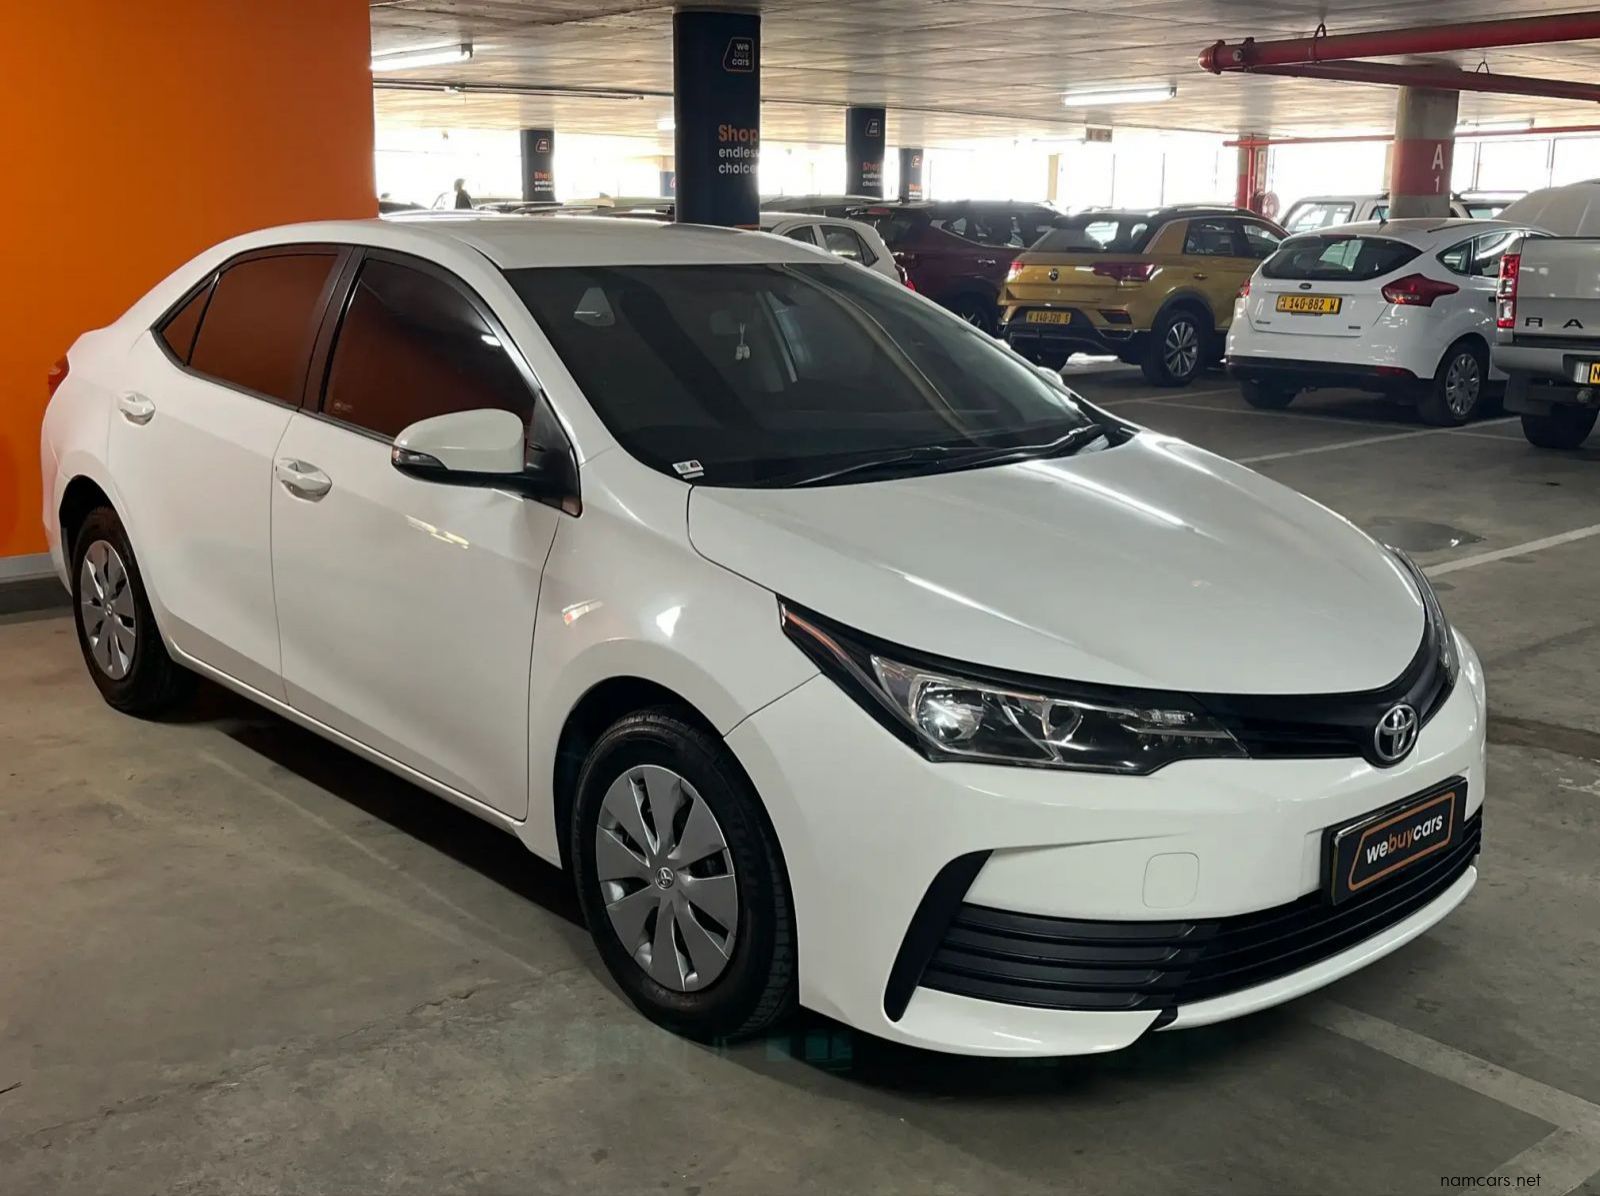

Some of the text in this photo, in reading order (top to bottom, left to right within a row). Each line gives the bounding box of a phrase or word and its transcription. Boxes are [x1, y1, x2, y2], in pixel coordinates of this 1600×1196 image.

[732, 58, 749, 66] cars
[718, 124, 758, 145] Shop
[1432, 143, 1444, 170] A
[1434, 175, 1440, 193] 1
